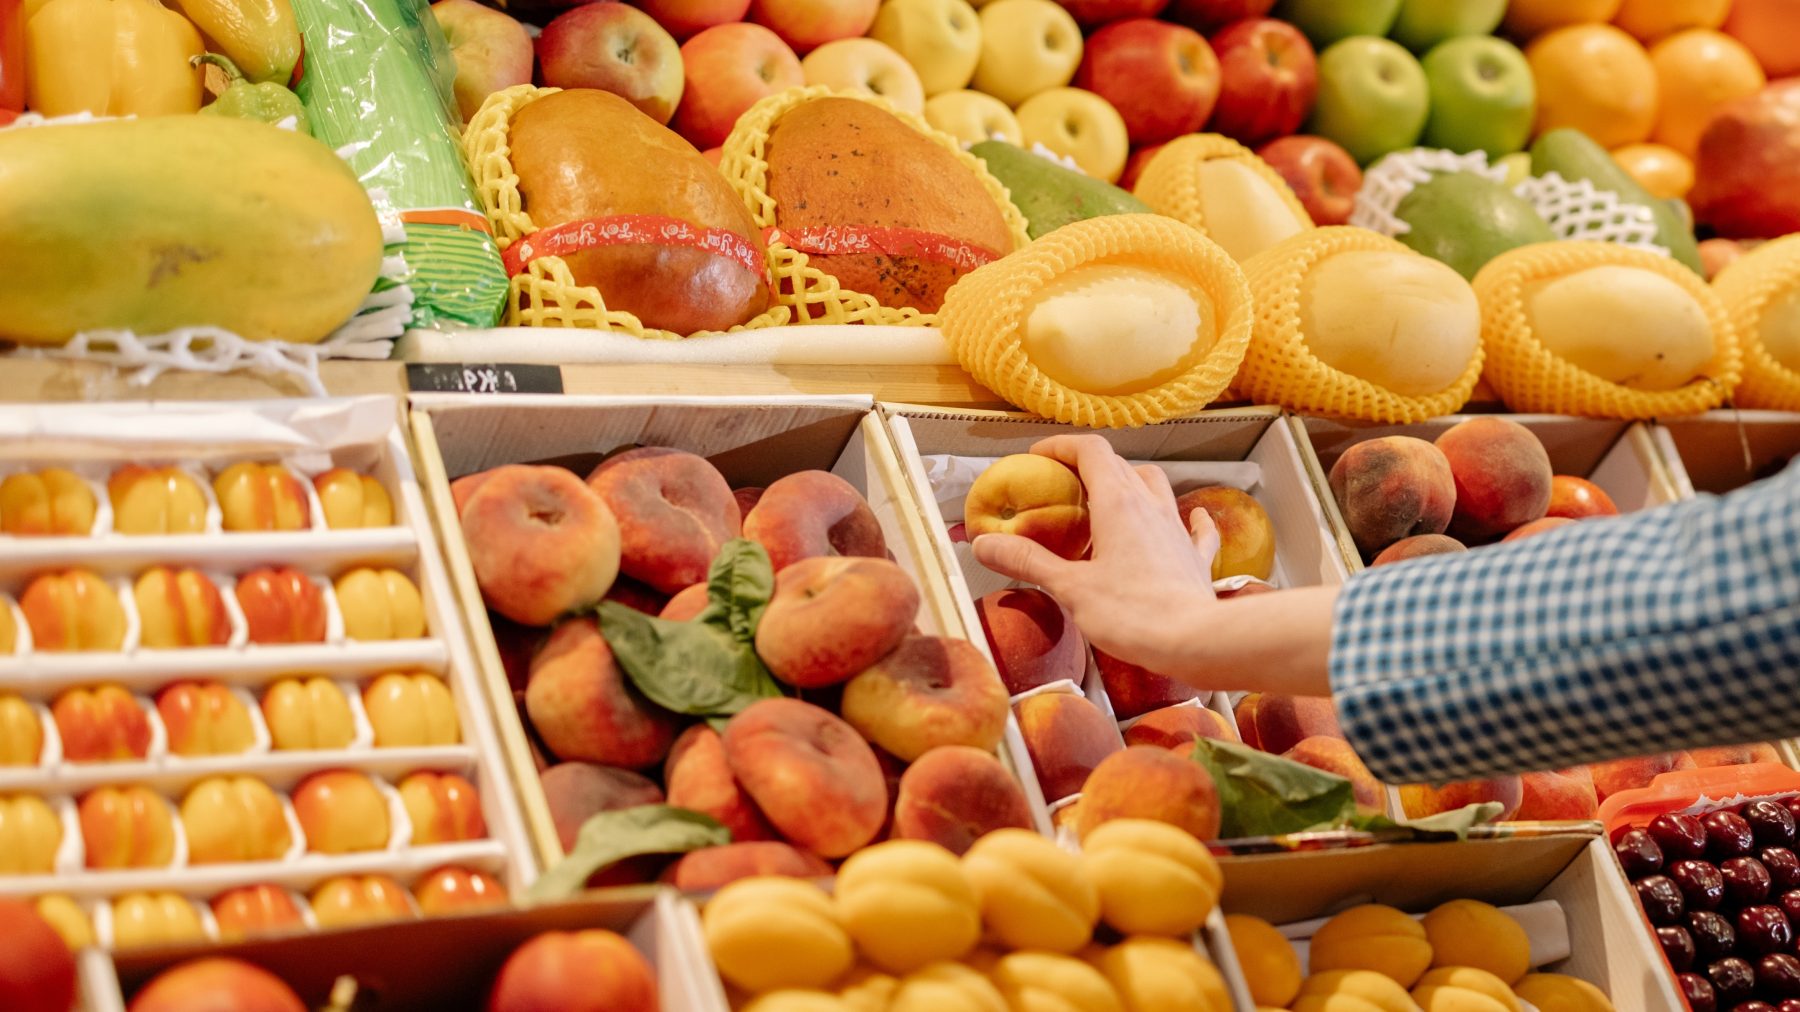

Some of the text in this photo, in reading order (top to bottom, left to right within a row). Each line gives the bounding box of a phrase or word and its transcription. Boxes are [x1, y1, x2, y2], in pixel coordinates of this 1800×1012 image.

[599, 222, 634, 240] For
[660, 223, 696, 240] For
[838, 233, 871, 248] For
